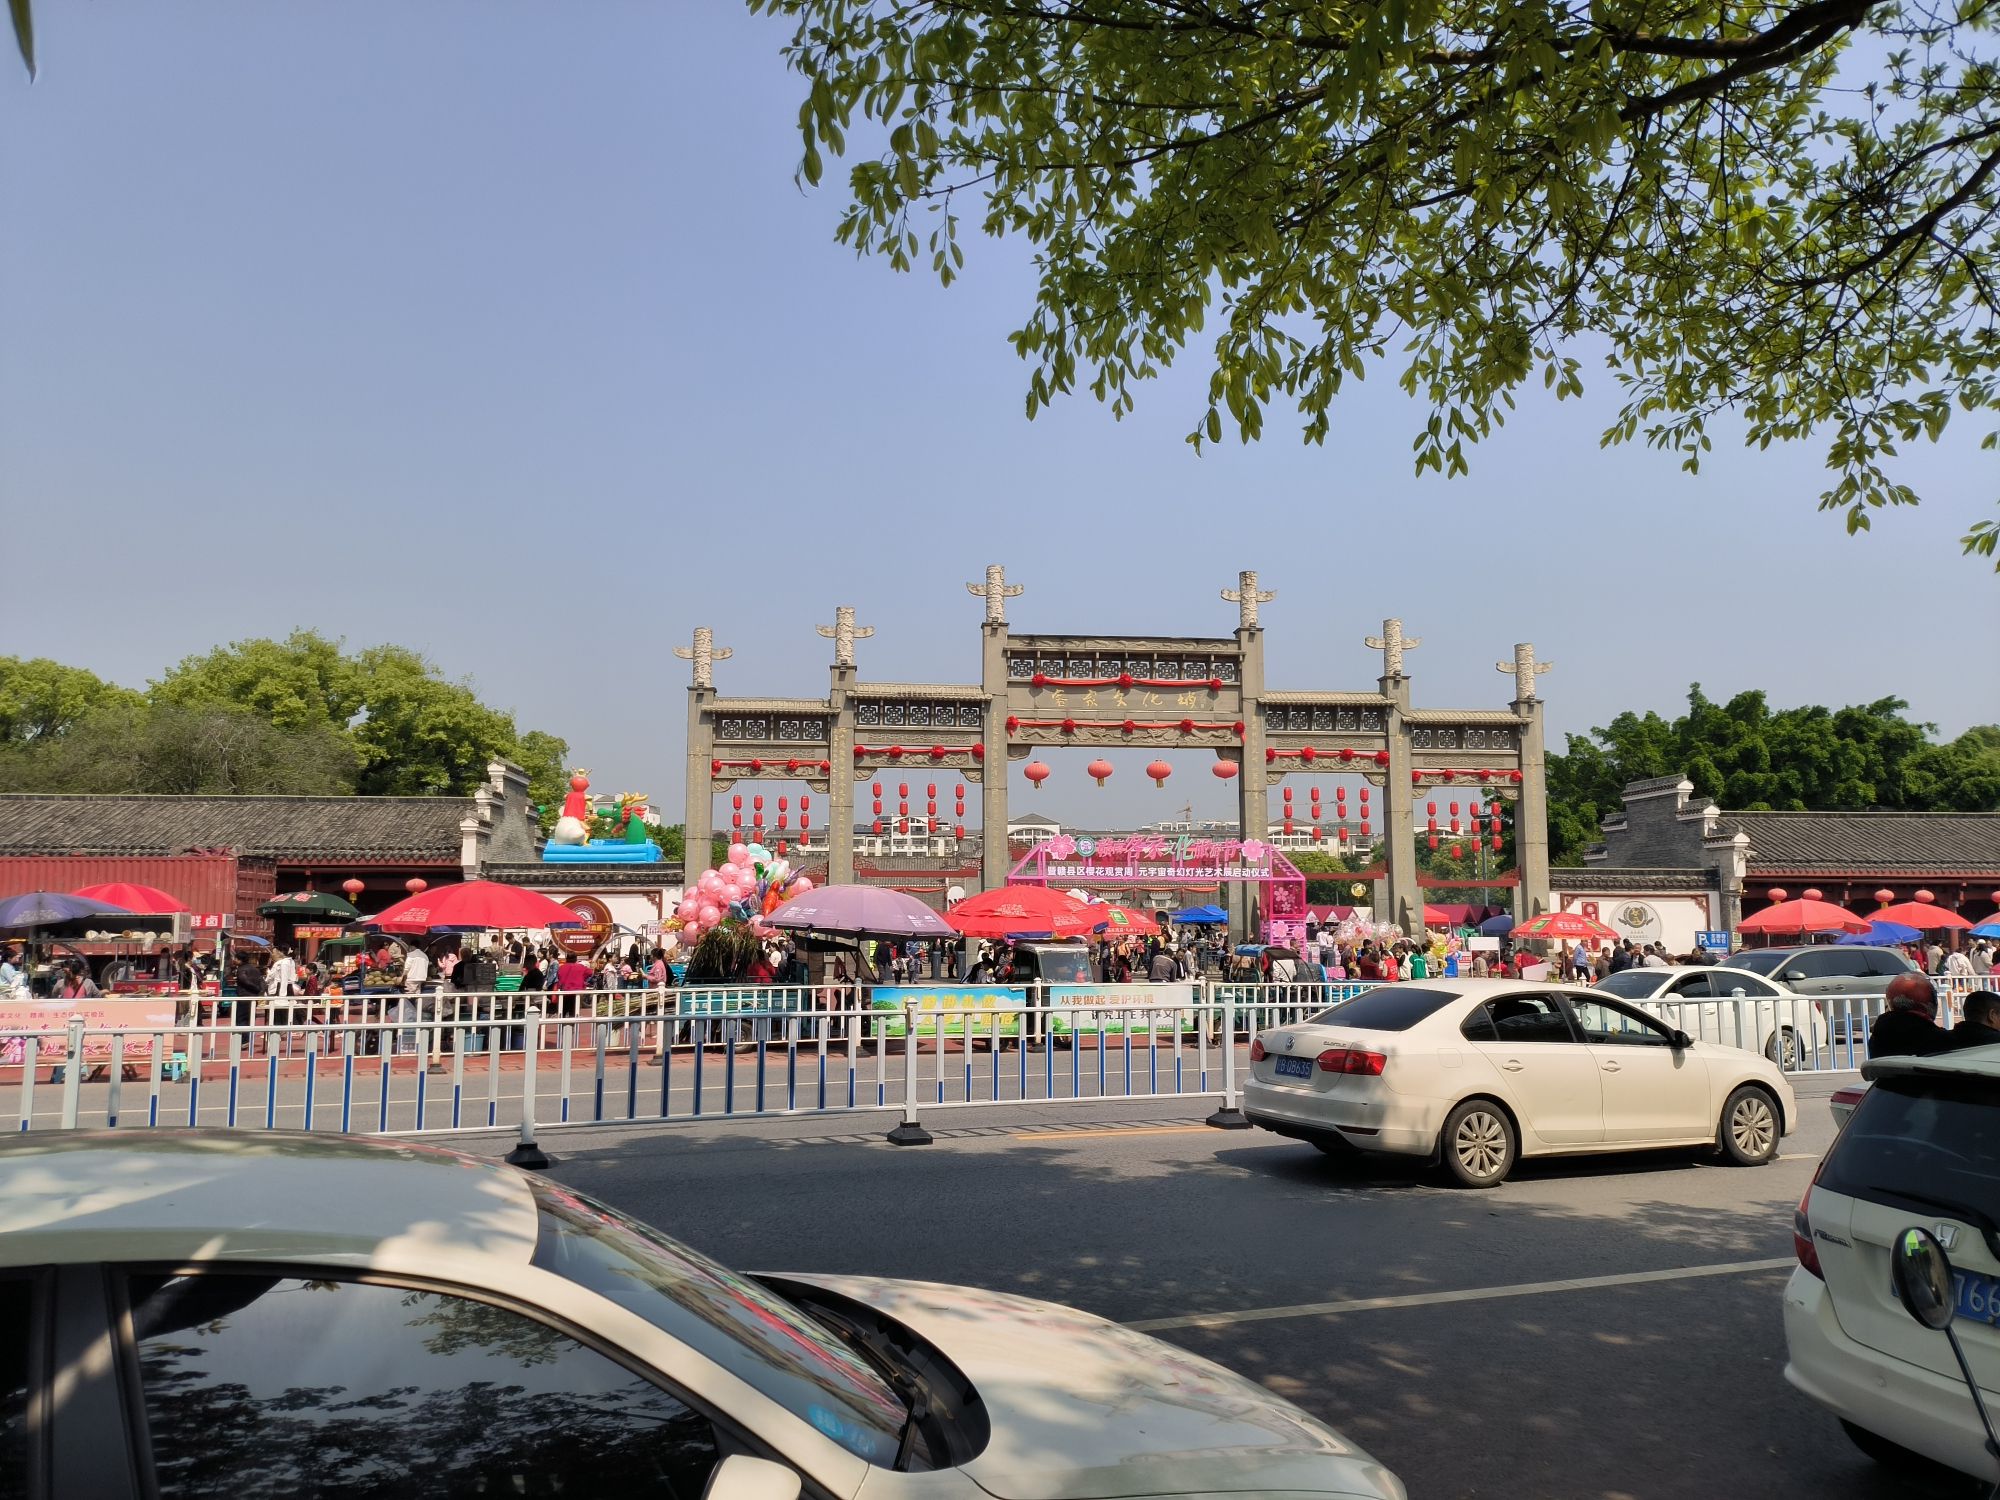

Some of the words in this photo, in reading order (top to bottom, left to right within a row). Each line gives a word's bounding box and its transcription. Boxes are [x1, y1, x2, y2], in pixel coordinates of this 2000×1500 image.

[1047, 866, 1133, 877] 暨赣县区樱花观赏周
[1138, 867, 1270, 877] 元宇宙奇幻灯光艺术展启动仪式
[1060, 994, 1106, 1006] 从我做起
[1109, 994, 1154, 1005] 爱护环境
